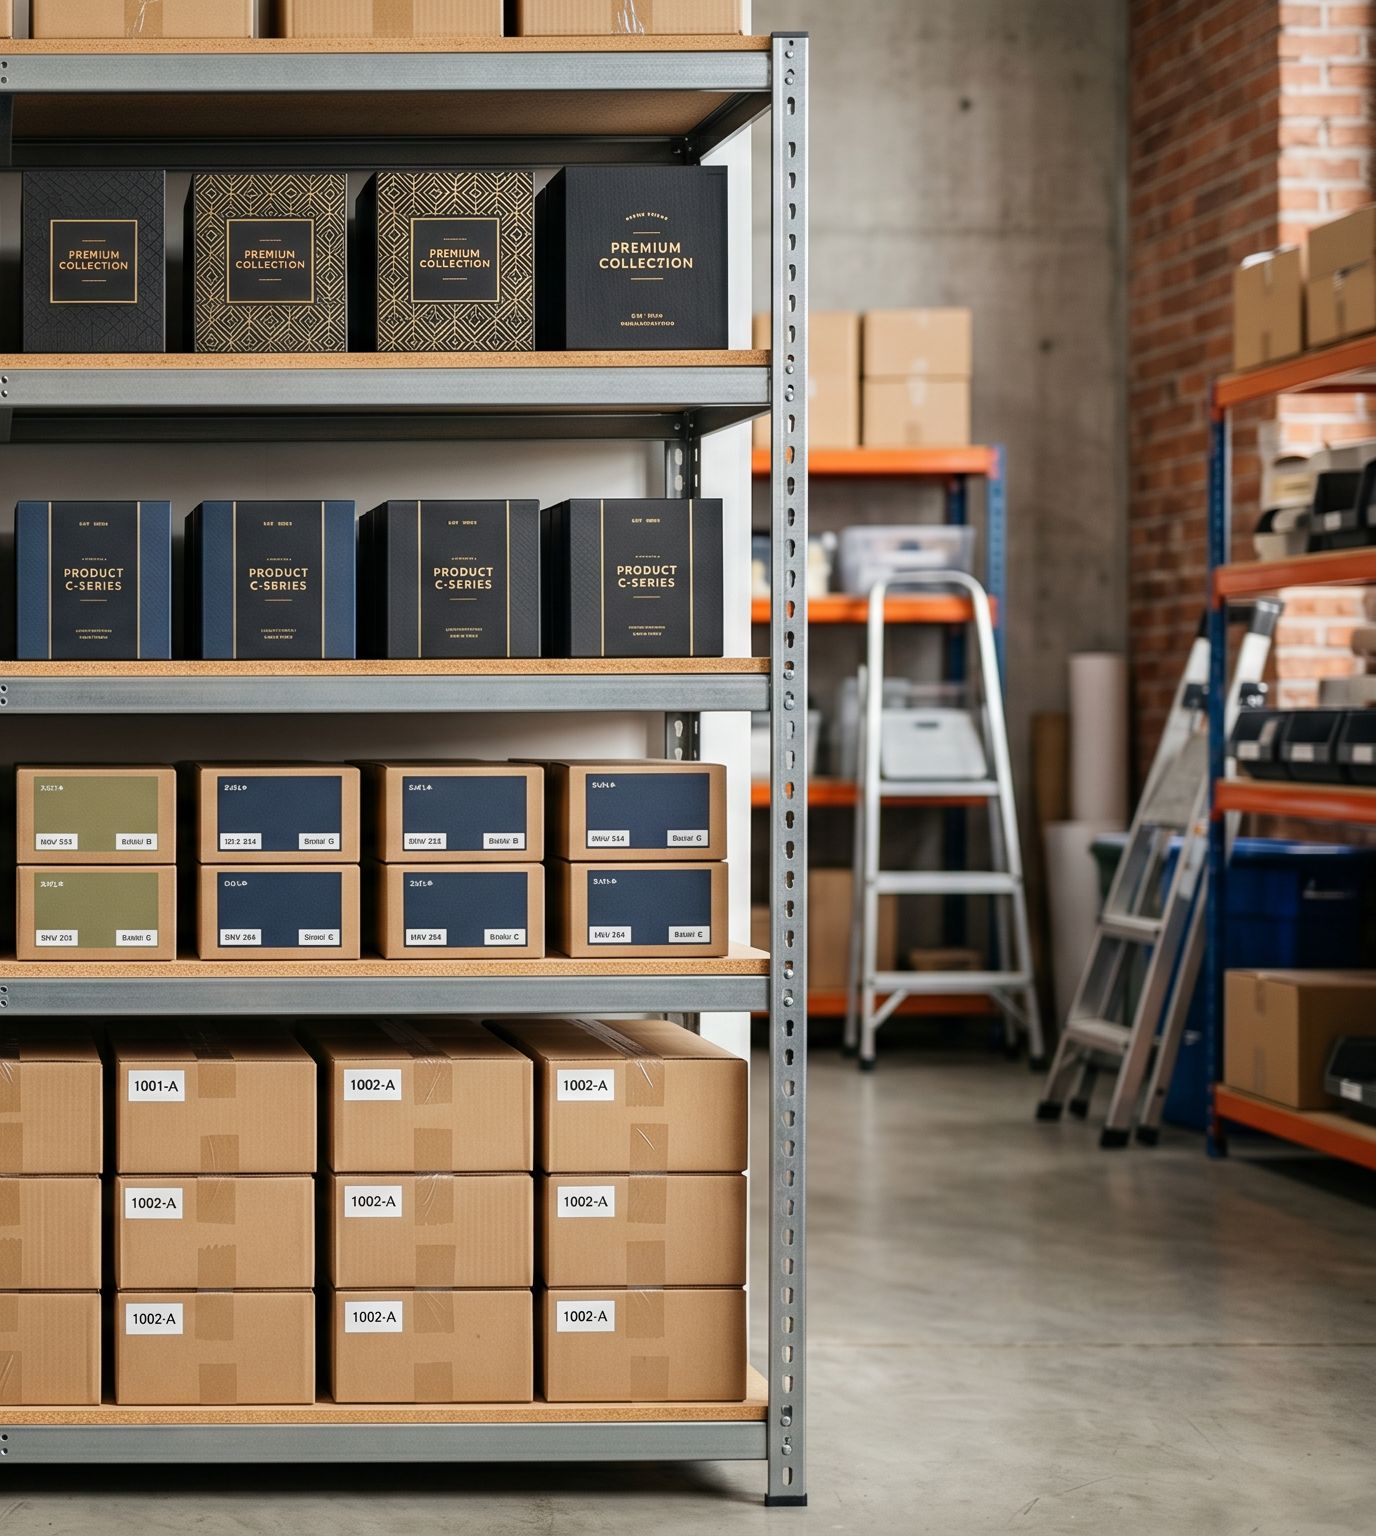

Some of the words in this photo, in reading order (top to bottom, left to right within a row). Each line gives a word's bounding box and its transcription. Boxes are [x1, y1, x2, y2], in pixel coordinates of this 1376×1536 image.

[430, 248, 480, 258] PREMIUM
[612, 242, 680, 254] PREMIUM
[68, 250, 120, 260] PREMIUM
[58, 262, 128, 270] COLLECTION
[236, 260, 304, 268] COLLECTION
[420, 260, 490, 268] COLLECTION
[600, 258, 692, 268] COLLECTION
[64, 568, 124, 578] PRODUCT
[250, 568, 308, 578] PRODUCT
[434, 566, 494, 576] PRODUCT
[616, 566, 678, 576] PRODUCT
[66, 580, 122, 590] C-SERIES
[434, 580, 492, 590] C-SERIES
[618, 578, 674, 588] C-SERIES
[134, 1080, 178, 1092] 1001-A
[350, 1078, 396, 1090] 1002-A
[564, 1080, 608, 1092] 1002-A
[132, 1198, 176, 1208] 1002-A
[352, 1196, 396, 1206] 1002-A
[564, 1196, 608, 1208] 1002-A
[132, 1312, 176, 1324] 1002-A
[354, 1310, 396, 1322] 1002-A
[564, 1310, 608, 1322] 1002-A
